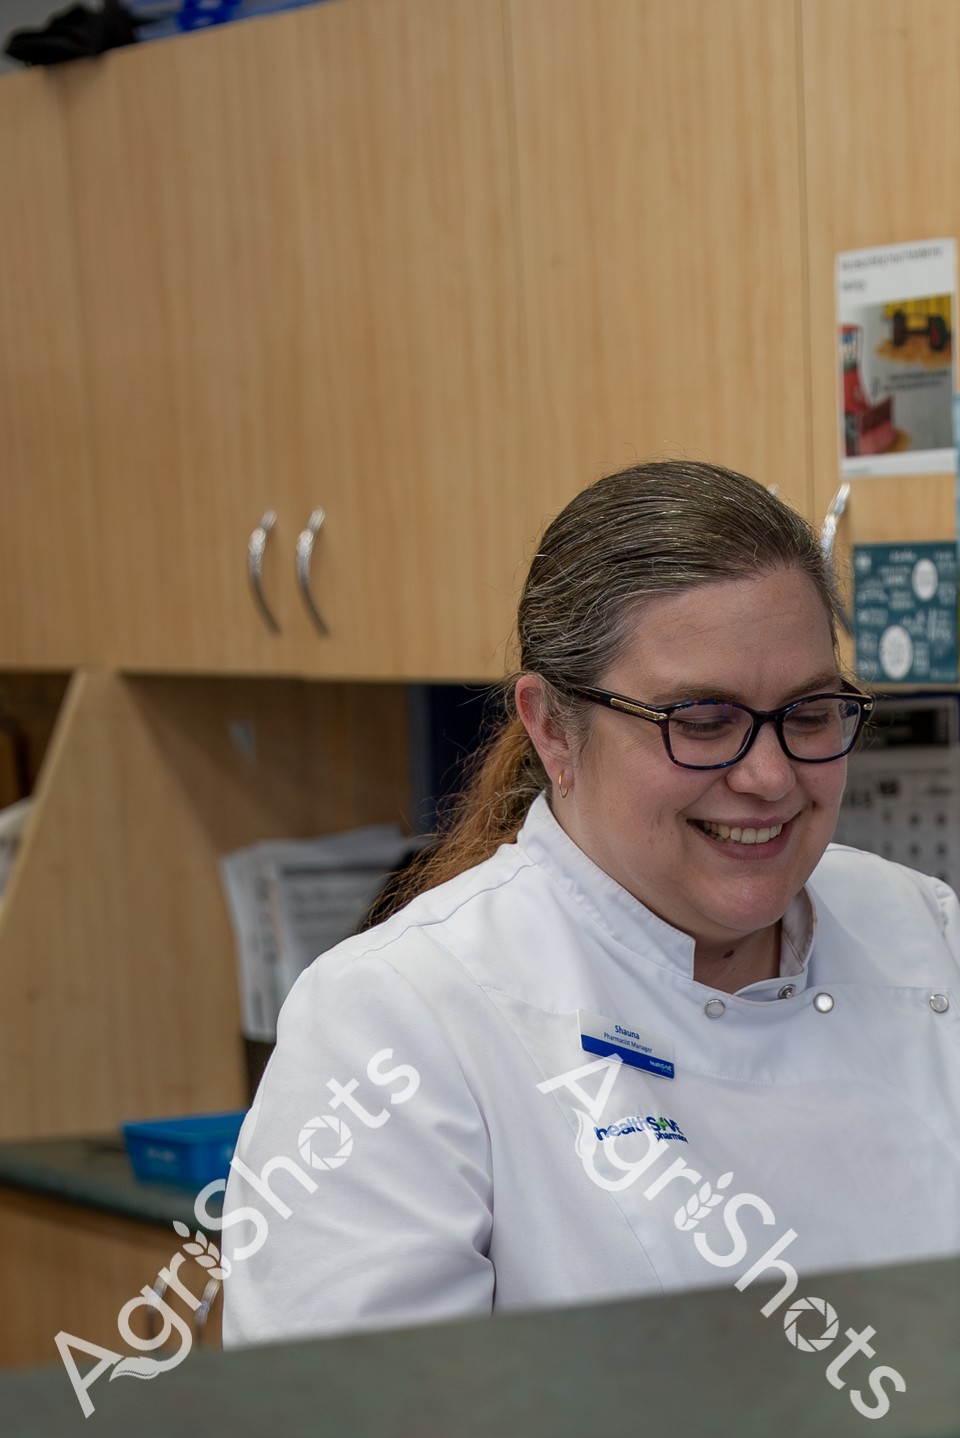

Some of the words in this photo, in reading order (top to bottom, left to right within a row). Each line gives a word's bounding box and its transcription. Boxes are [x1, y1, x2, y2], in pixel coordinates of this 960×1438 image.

[615, 1024, 640, 1040] Shauna
[603, 1031, 631, 1047] Pharmacist
[630, 1040, 653, 1053] Manager
